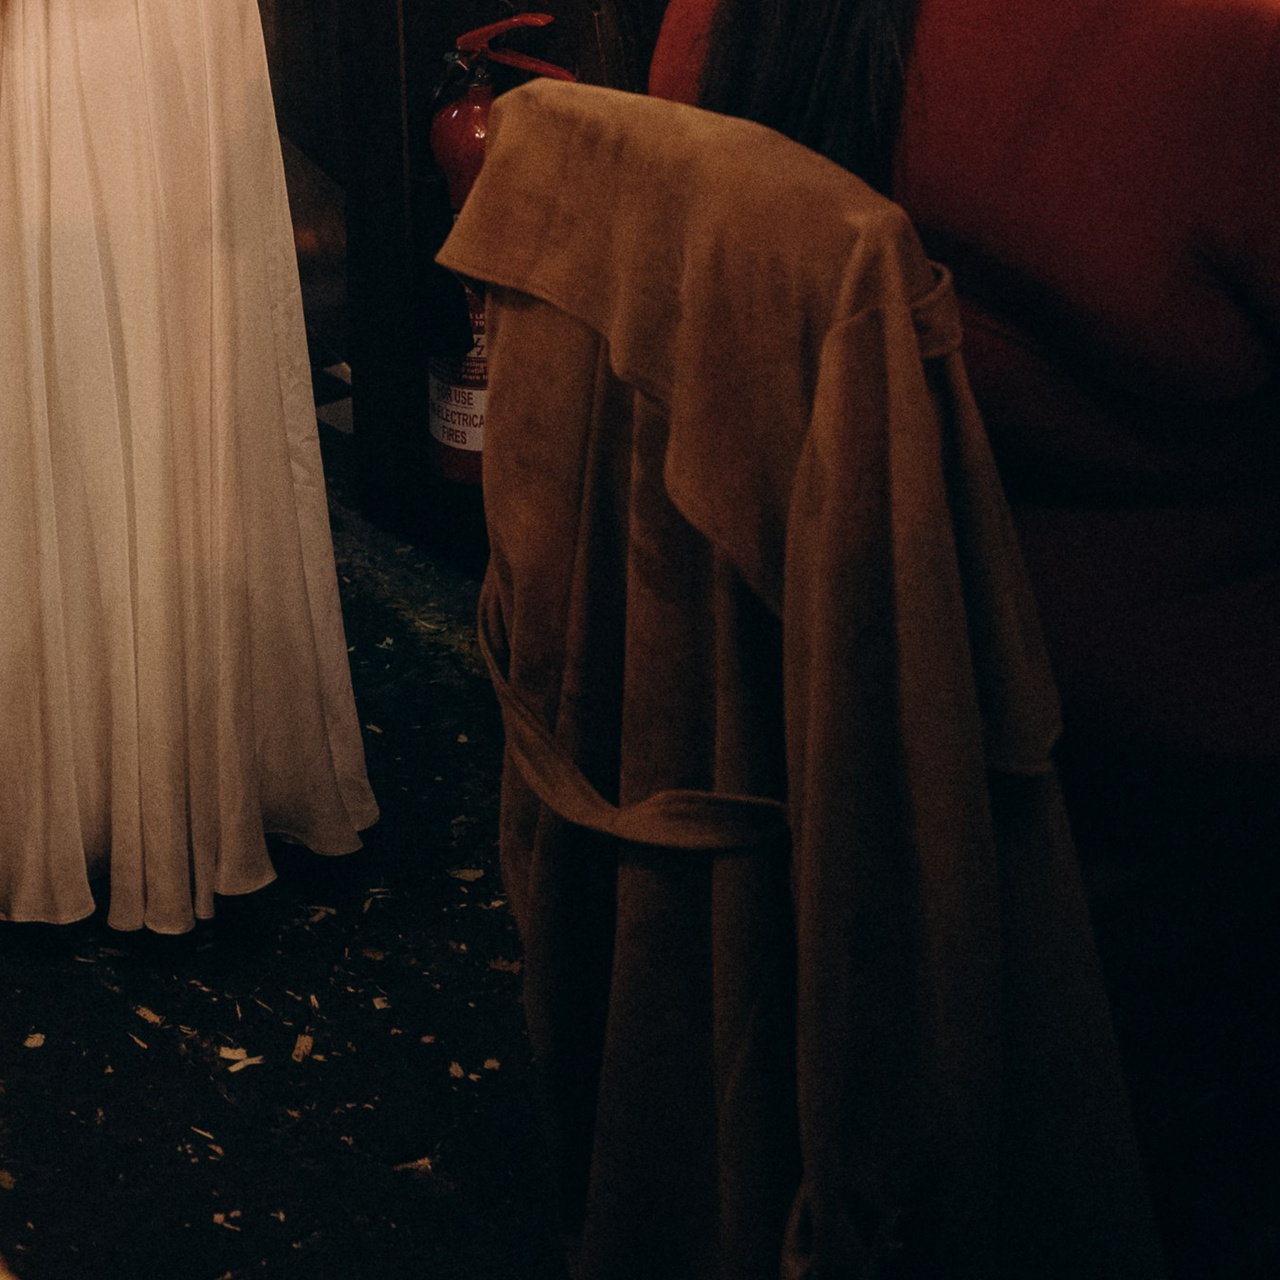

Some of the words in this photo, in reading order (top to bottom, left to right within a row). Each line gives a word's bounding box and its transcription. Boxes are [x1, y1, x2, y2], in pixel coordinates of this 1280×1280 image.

[437, 384, 452, 402] FOR
[455, 389, 473, 406] USE
[437, 405, 485, 429] ELECTRICA
[441, 425, 467, 445] FIRES
